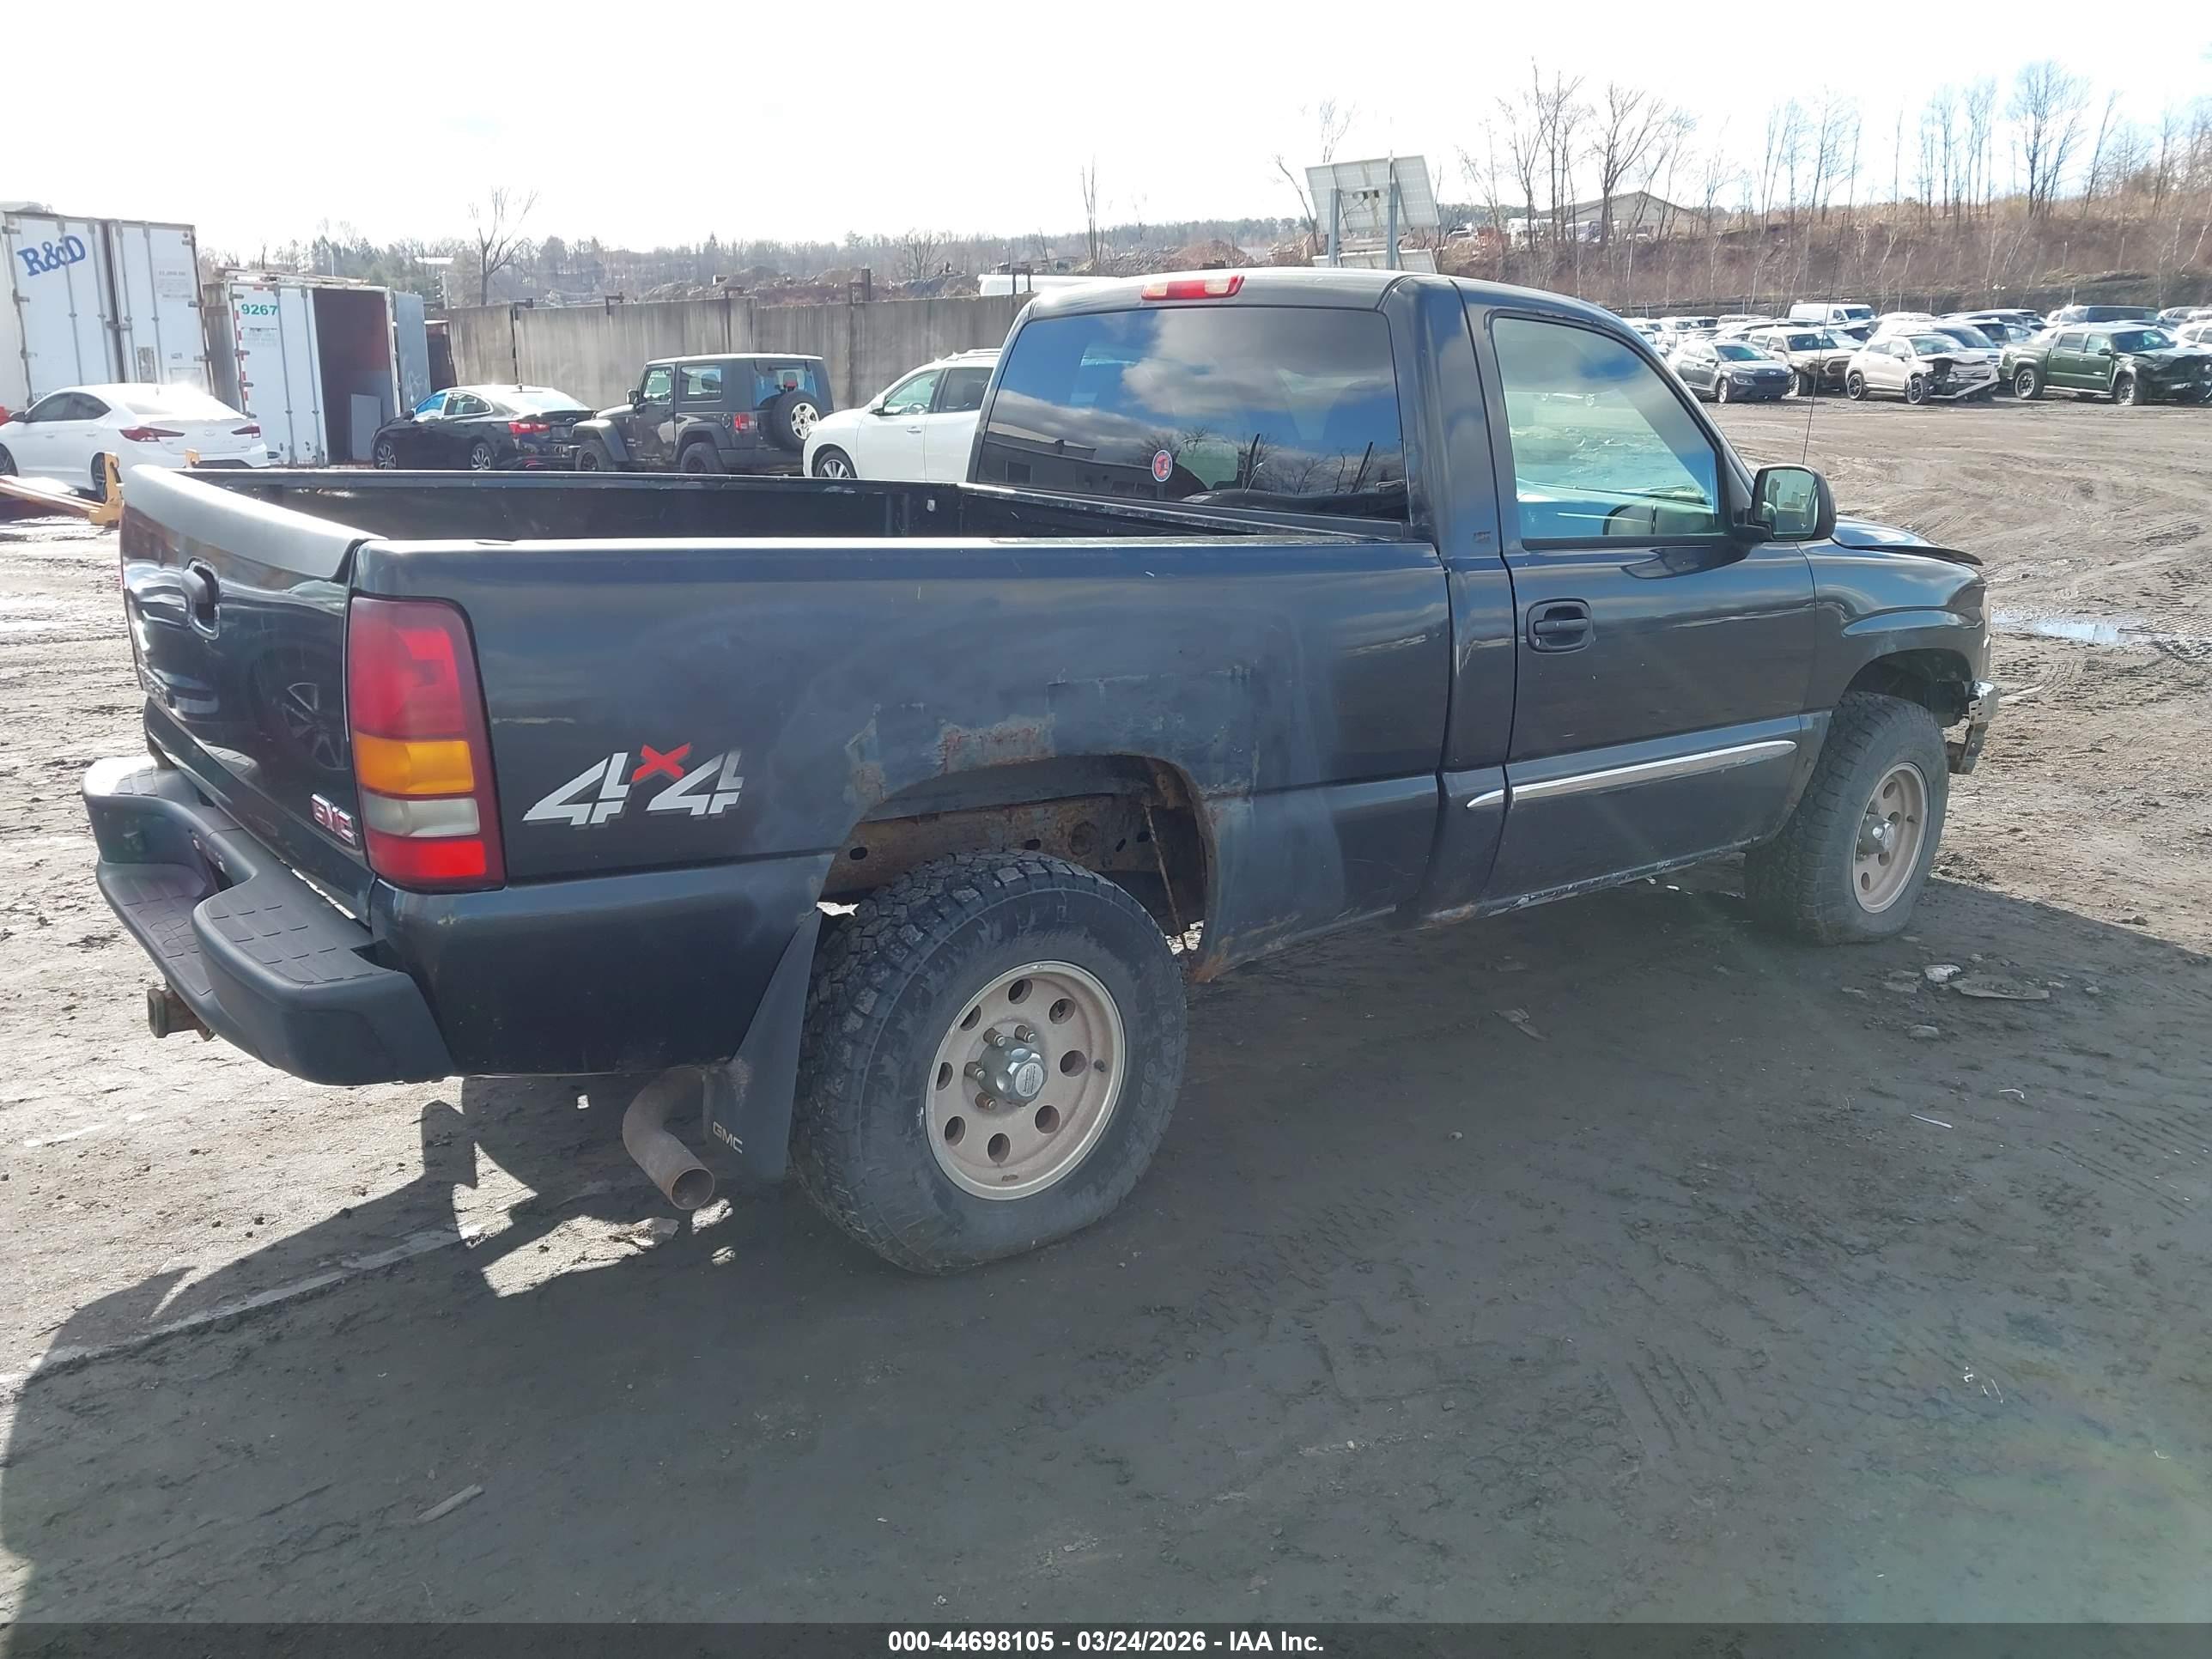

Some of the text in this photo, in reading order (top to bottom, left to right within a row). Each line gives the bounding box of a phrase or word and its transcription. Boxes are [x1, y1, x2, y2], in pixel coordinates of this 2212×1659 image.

[16, 235, 86, 276] R&D
[241, 303, 278, 316] 9267
[310, 793, 356, 847] GMC
[713, 1121, 743, 1154] GMC
